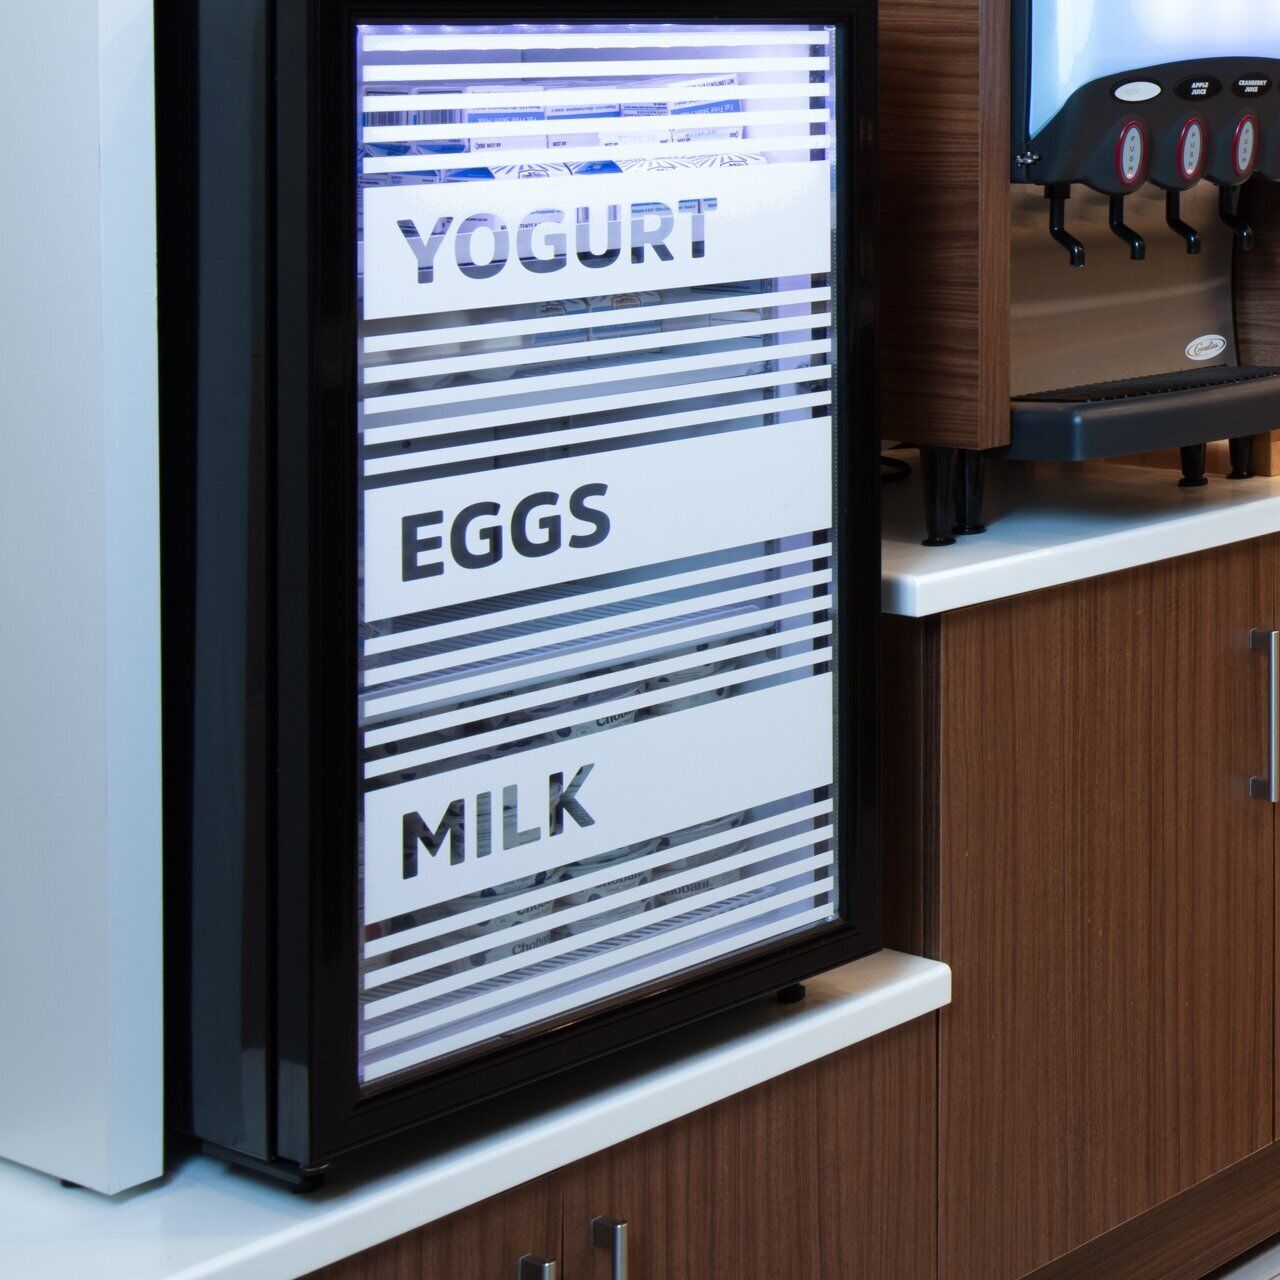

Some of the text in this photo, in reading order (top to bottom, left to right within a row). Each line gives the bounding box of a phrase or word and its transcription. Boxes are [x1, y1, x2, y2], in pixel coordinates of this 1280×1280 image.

[1128, 135, 1136, 171] PUSH
[1188, 132, 1196, 167] PUSH
[1242, 129, 1250, 163] PUSH
[397, 197, 718, 284] YOGURT
[401, 482, 611, 583] EGGS
[402, 762, 596, 880] MILK
